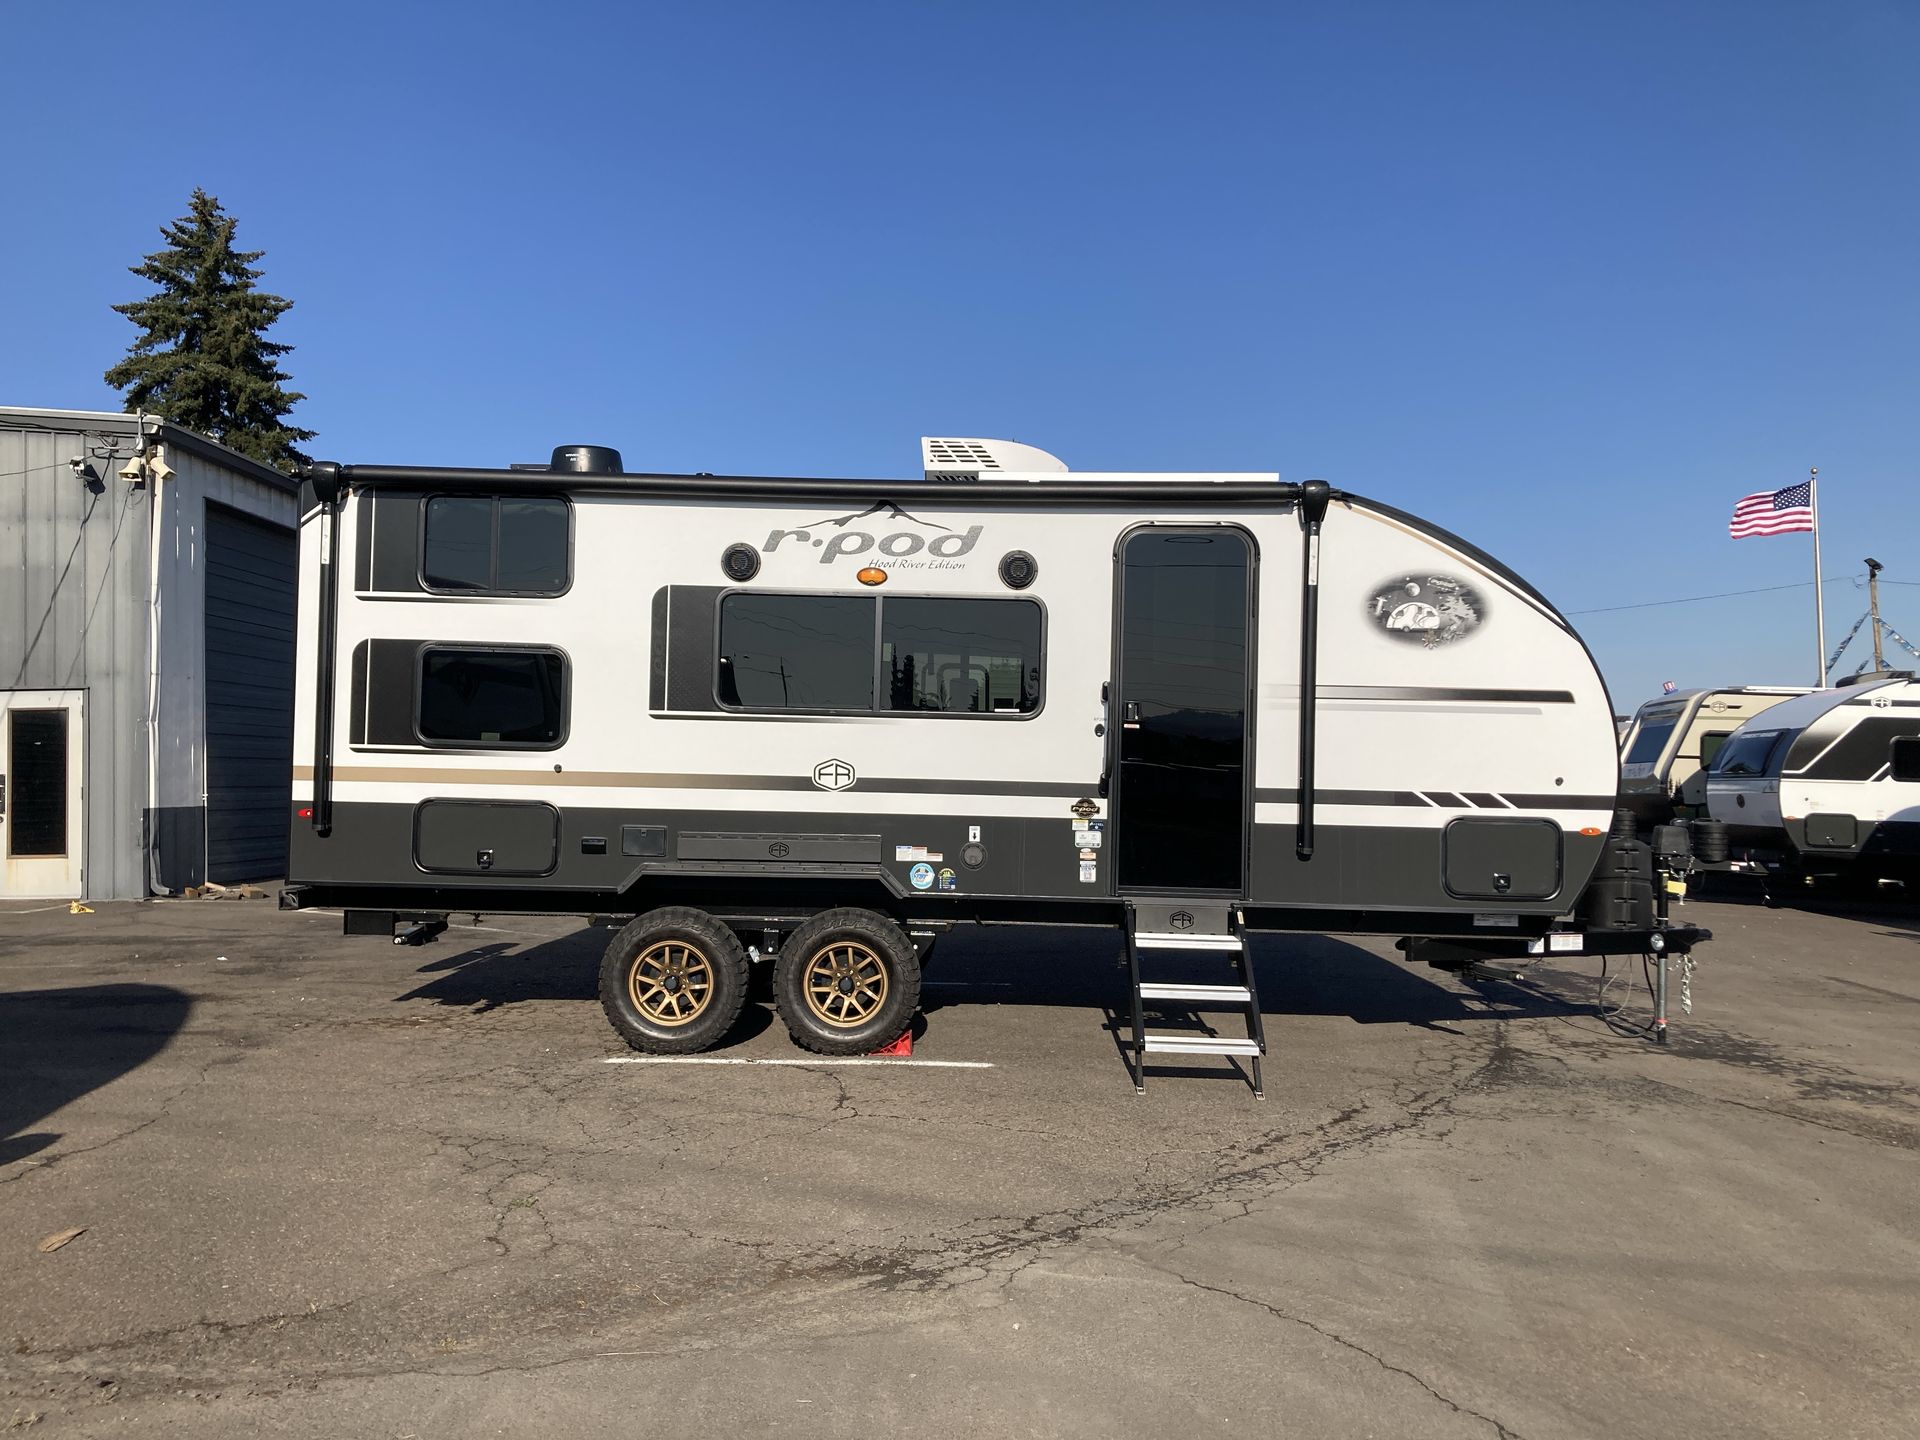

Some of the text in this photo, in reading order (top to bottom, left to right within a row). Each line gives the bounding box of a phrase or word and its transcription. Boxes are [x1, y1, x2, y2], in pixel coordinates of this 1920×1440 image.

[868, 558, 966, 570] Hood River Edition
